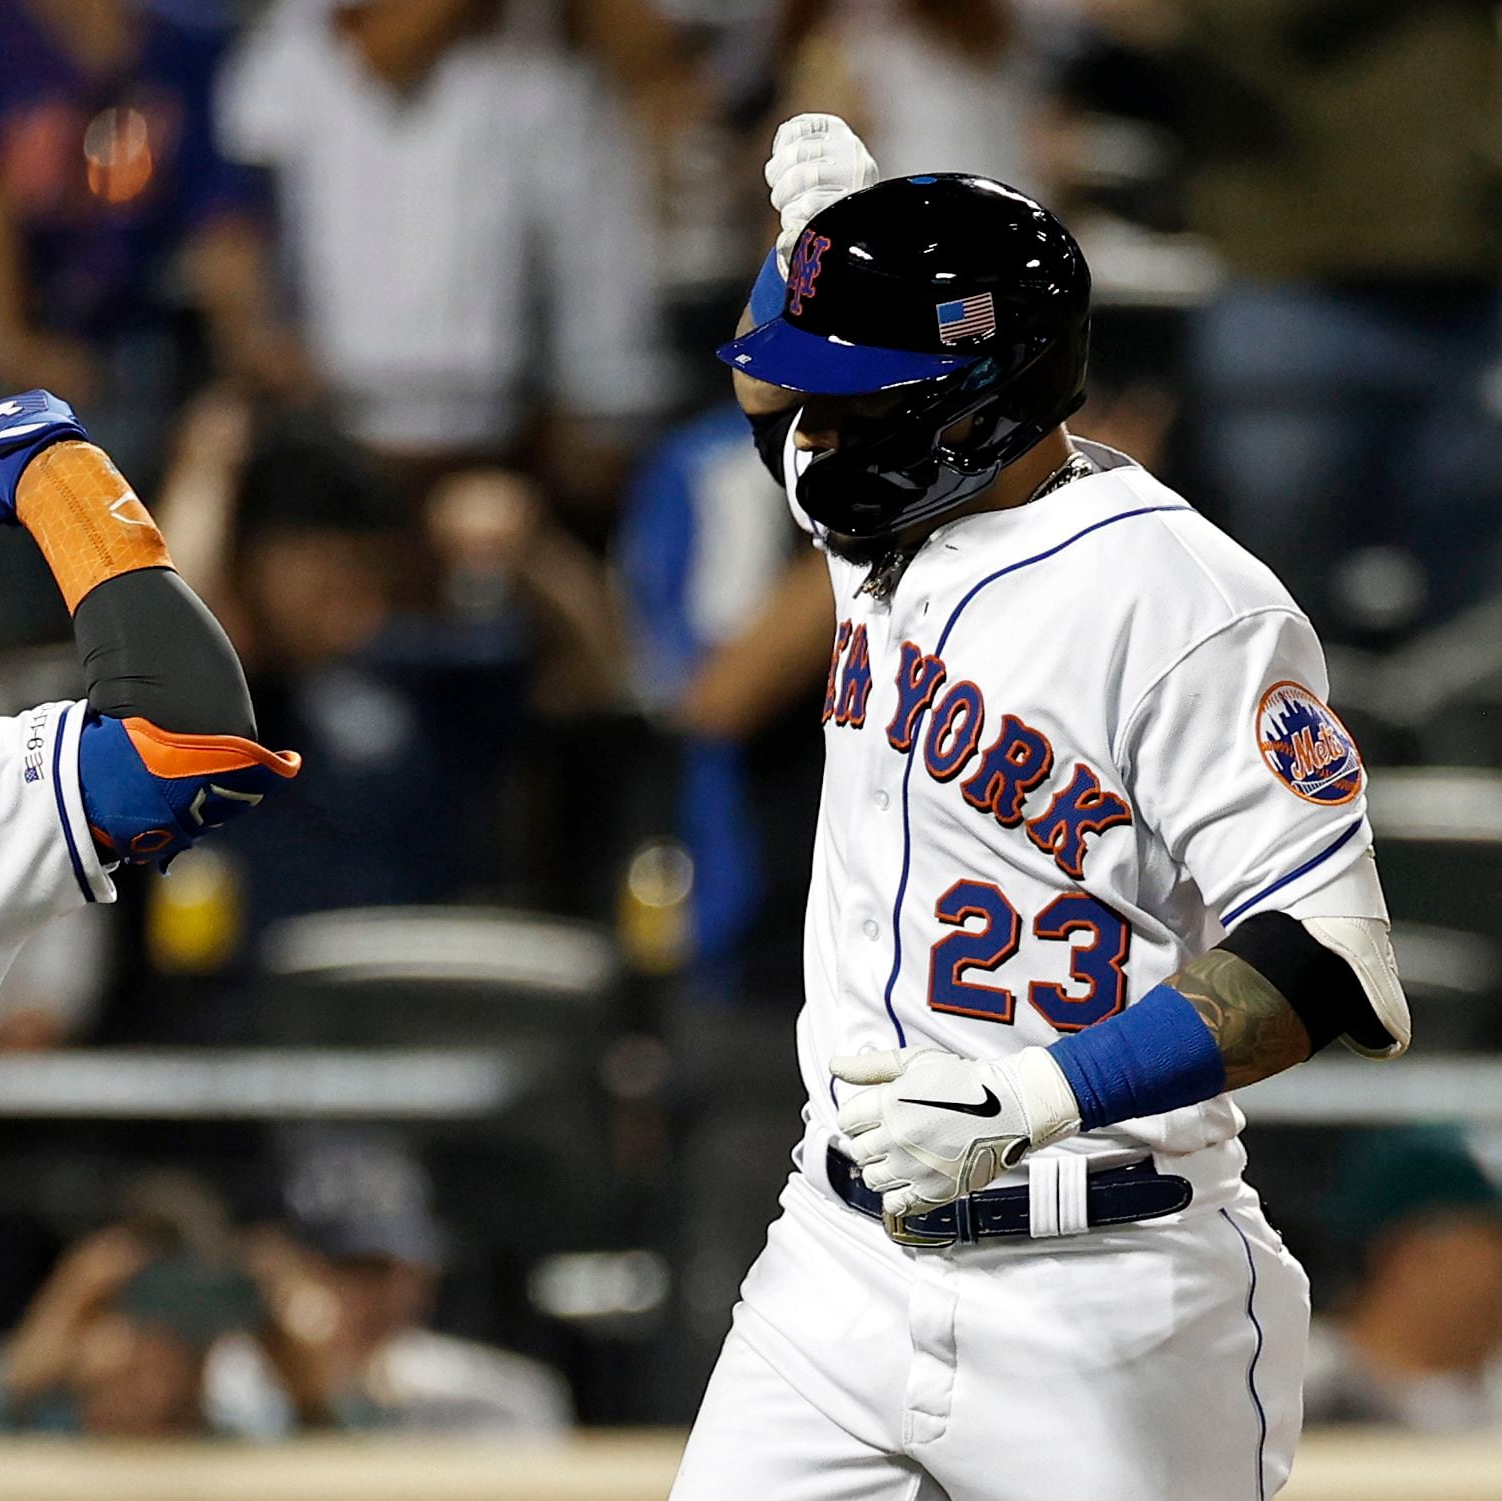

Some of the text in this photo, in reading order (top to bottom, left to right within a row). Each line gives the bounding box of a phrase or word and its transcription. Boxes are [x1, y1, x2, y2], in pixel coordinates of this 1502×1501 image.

[822, 618, 1133, 881] EW YORK
[1290, 722, 1346, 780] Mets
[927, 878, 1132, 1033] 23
